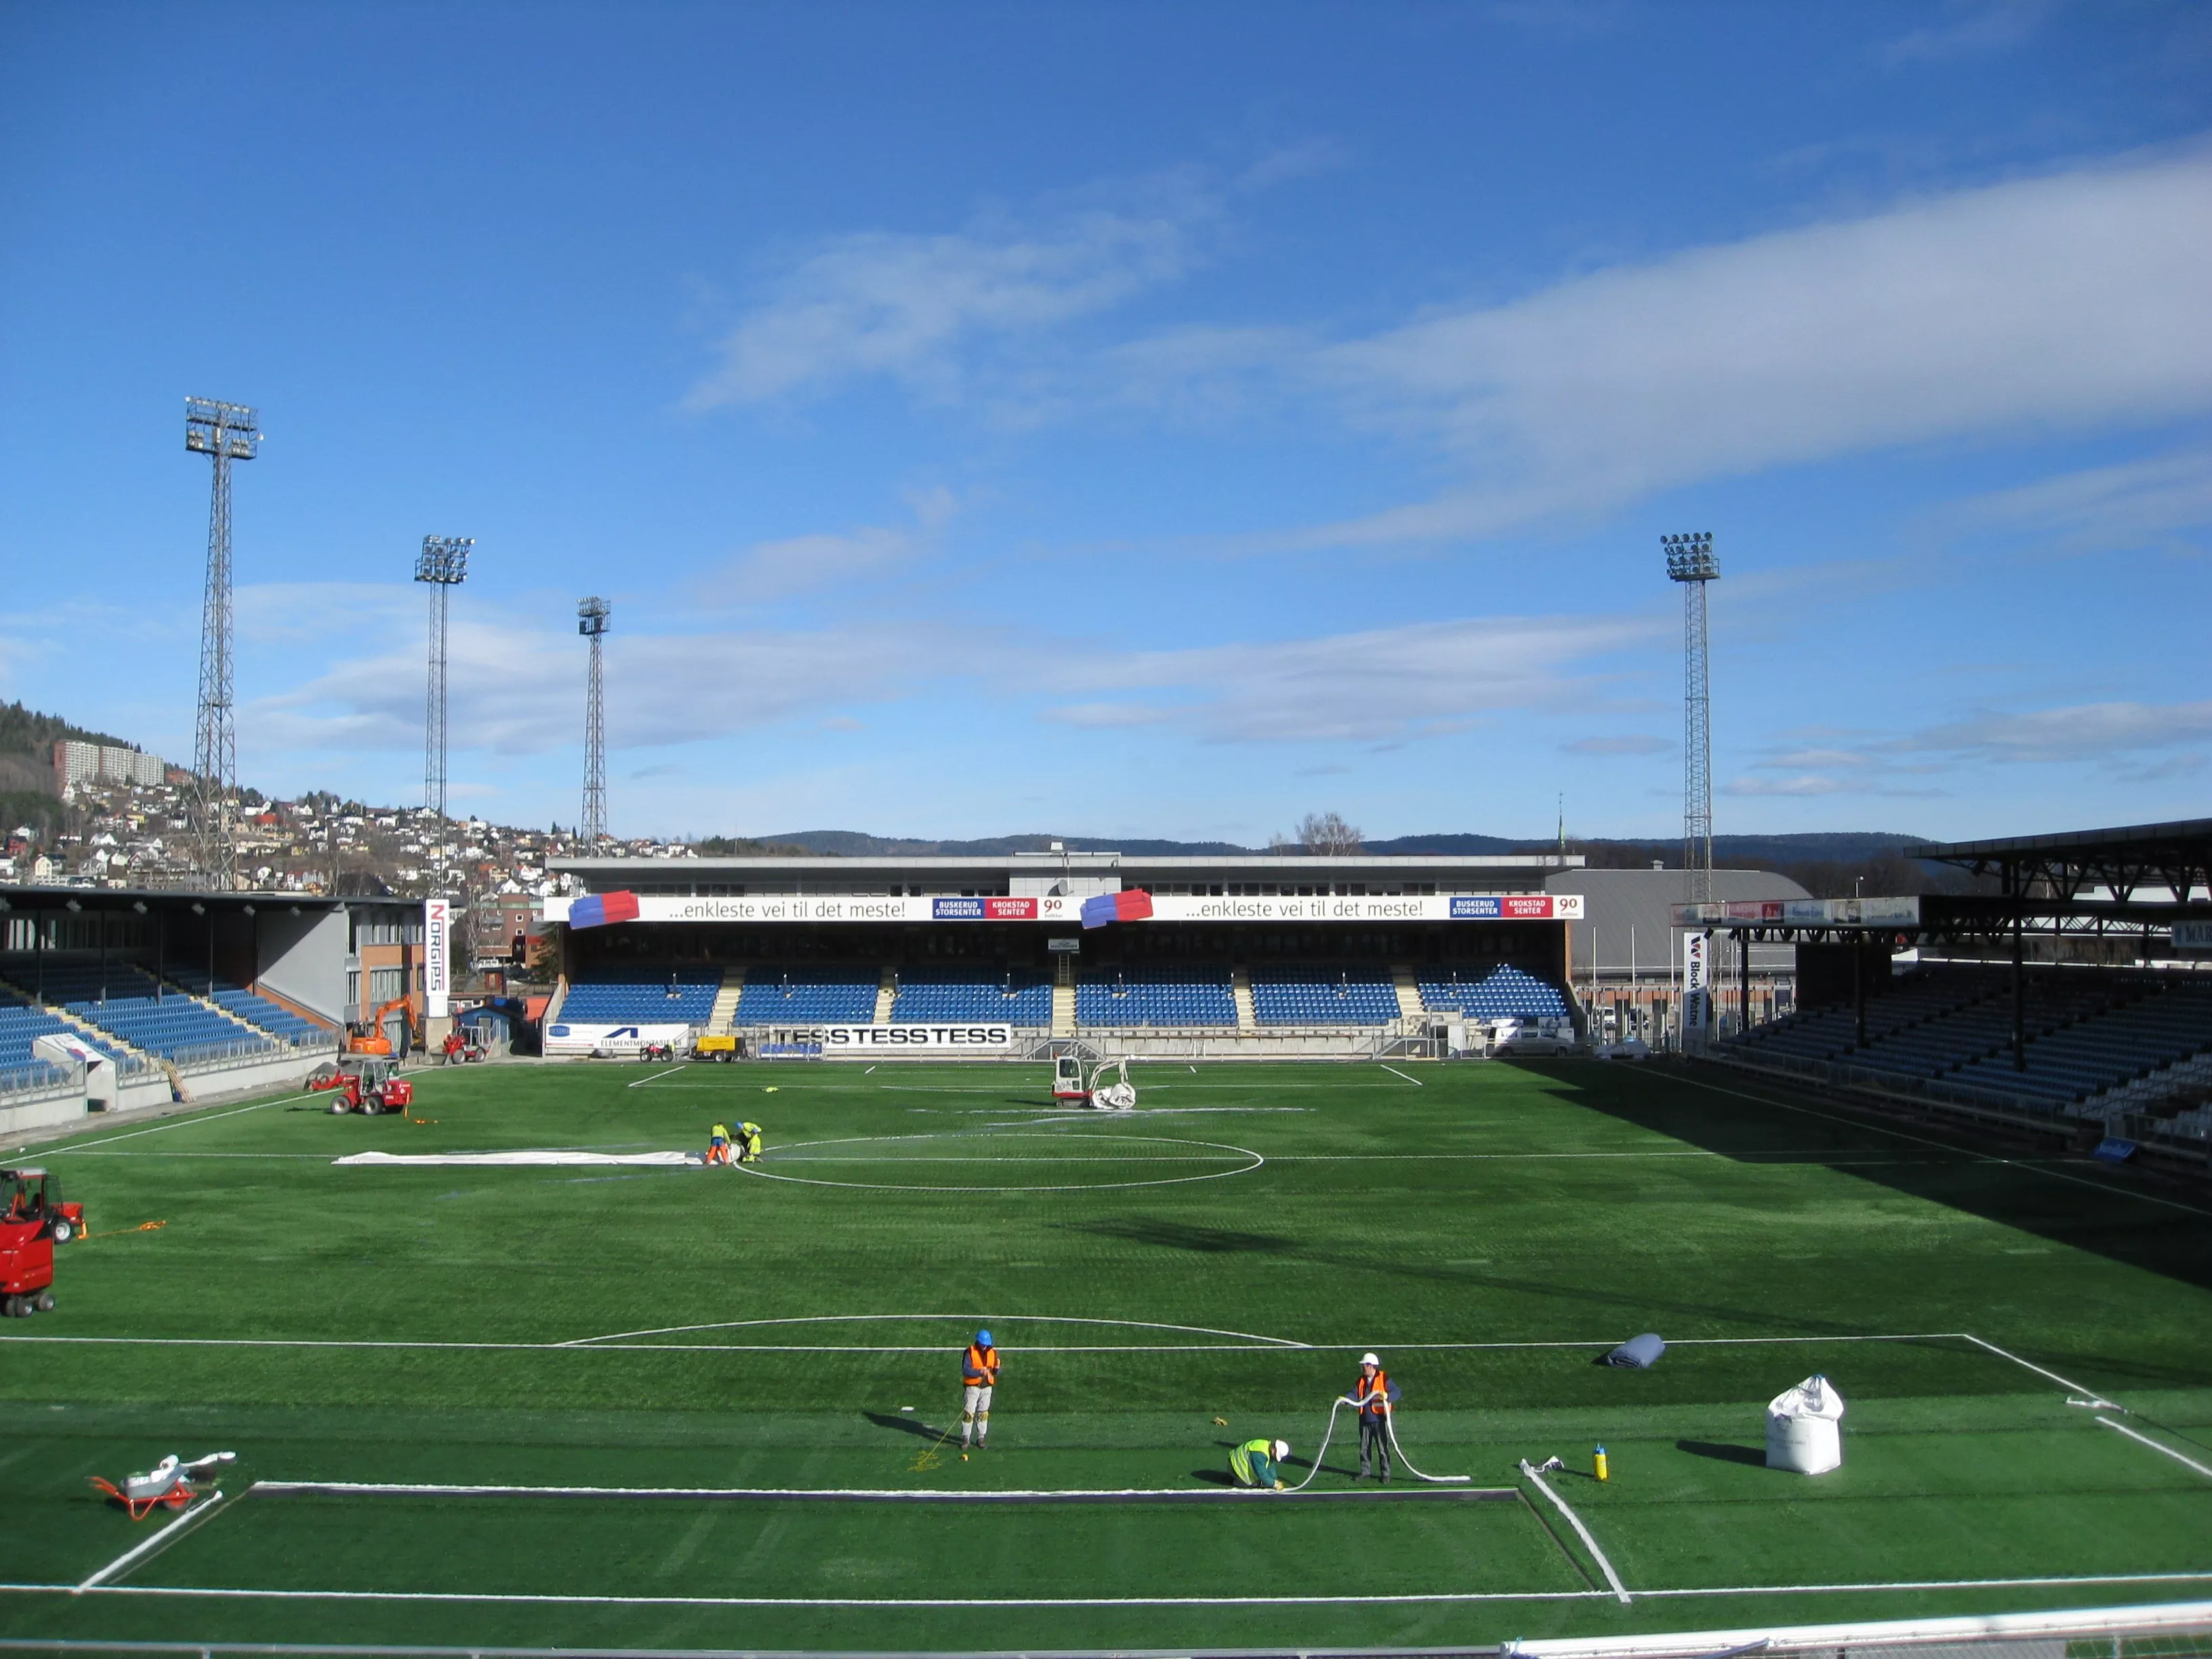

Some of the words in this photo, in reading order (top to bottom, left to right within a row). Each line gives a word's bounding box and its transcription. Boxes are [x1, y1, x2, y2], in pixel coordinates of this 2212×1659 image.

[762, 901, 785, 918] vei
[793, 901, 808, 918] til
[815, 901, 842, 918] det
[850, 901, 905, 918] meste!
[935, 908, 981, 916] STORSENTER
[998, 908, 1025, 916] SENTER
[1044, 899, 1062, 914] 90
[1279, 900, 1303, 918] vei
[1310, 900, 1326, 918] til
[1334, 900, 1361, 918] det
[1368, 900, 1422, 918] meste!
[1559, 898, 1577, 912] 90
[430, 904, 445, 991] NORGIPS
[1690, 961, 1700, 989] Block
[1689, 993, 1700, 1027] Watne
